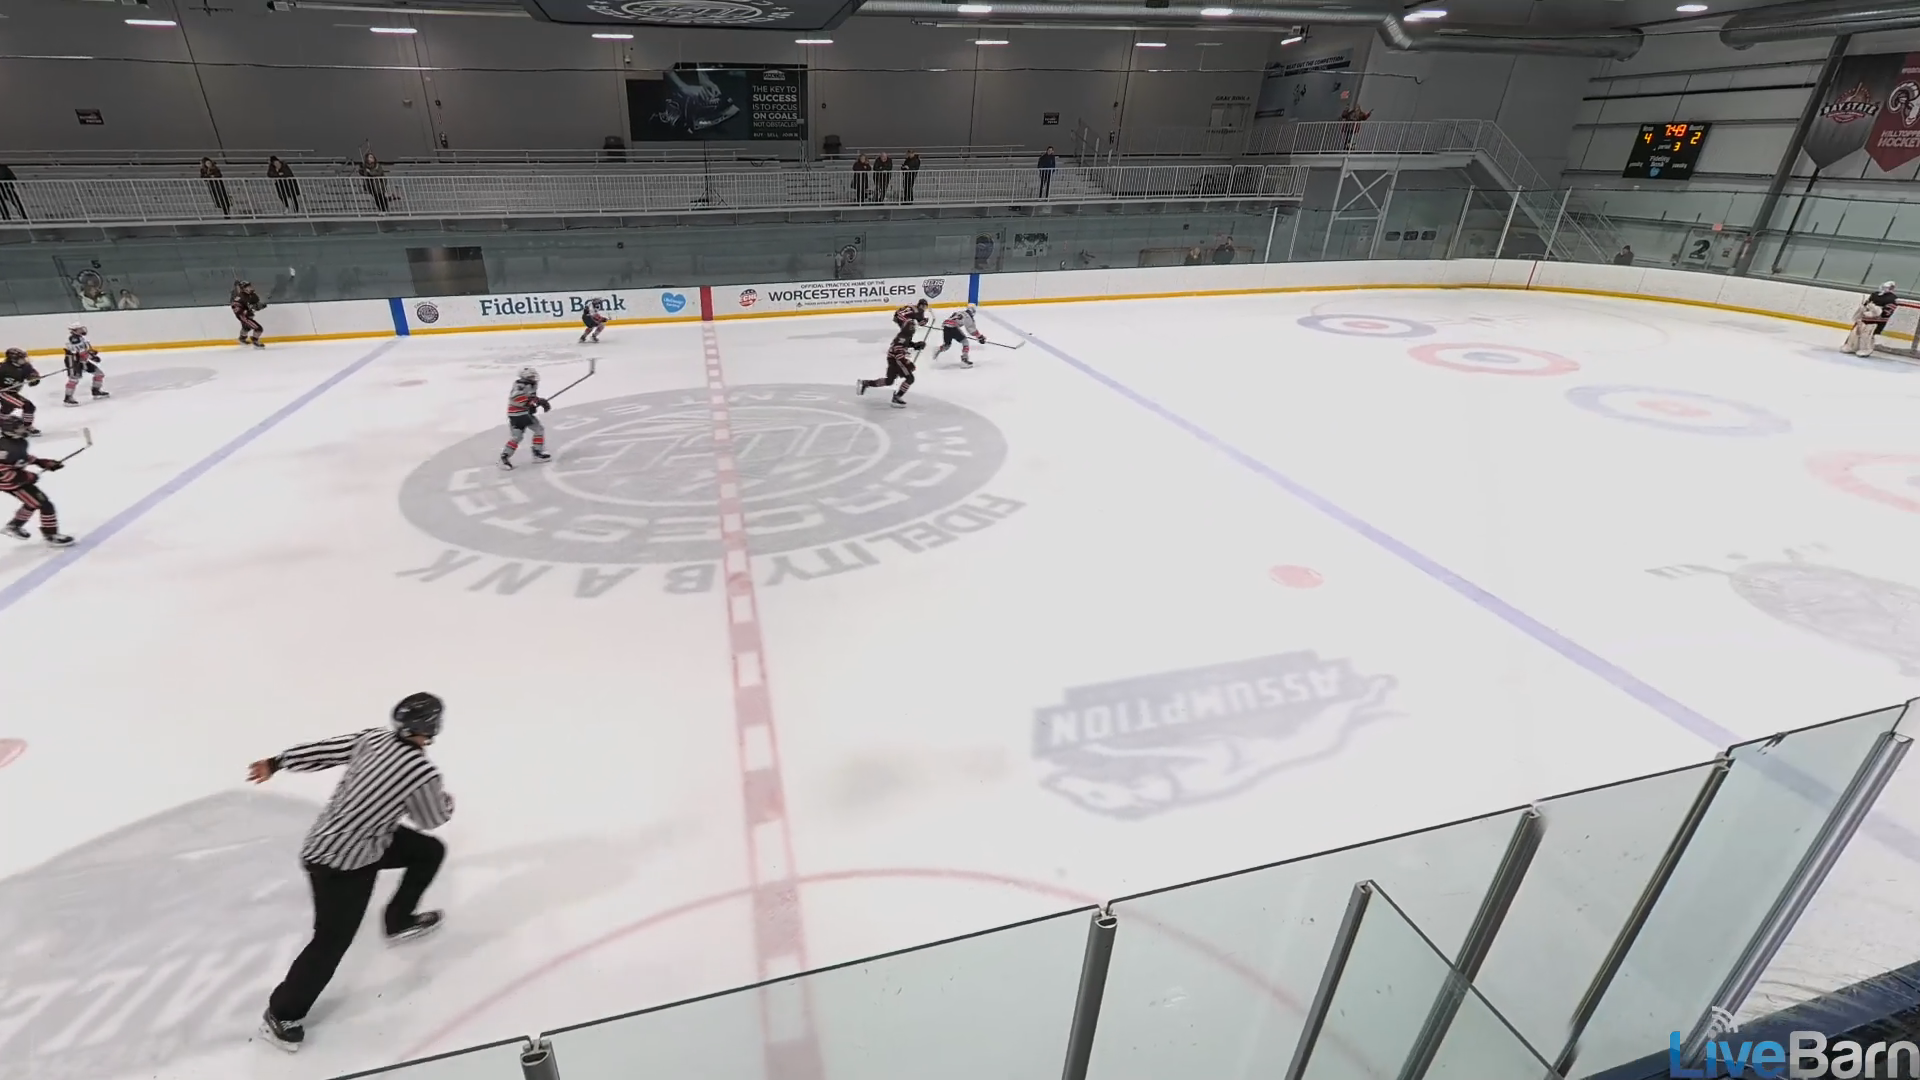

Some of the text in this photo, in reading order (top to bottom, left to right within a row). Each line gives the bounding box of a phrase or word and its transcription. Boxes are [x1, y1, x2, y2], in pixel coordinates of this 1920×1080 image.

[752, 94, 797, 102] SUCCESS
[752, 103, 798, 111] IS TO FOCUS
[1823, 102, 1877, 114] BAY STATE
[753, 112, 798, 120] ON GOALS
[1644, 132, 1653, 144] 4
[1690, 131, 1701, 145] 2
[1673, 141, 1681, 152] 3
[854, 236, 861, 245] 3
[1688, 239, 1711, 260] 2
[91, 259, 102, 269] 5
[768, 288, 856, 302] WORCESTER
[860, 284, 916, 297] RAILERS
[479, 296, 563, 318] Fidelity
[395, 493, 1027, 599] FIDELITY BANK
[1050, 666, 1343, 745] ASSUMPTION
